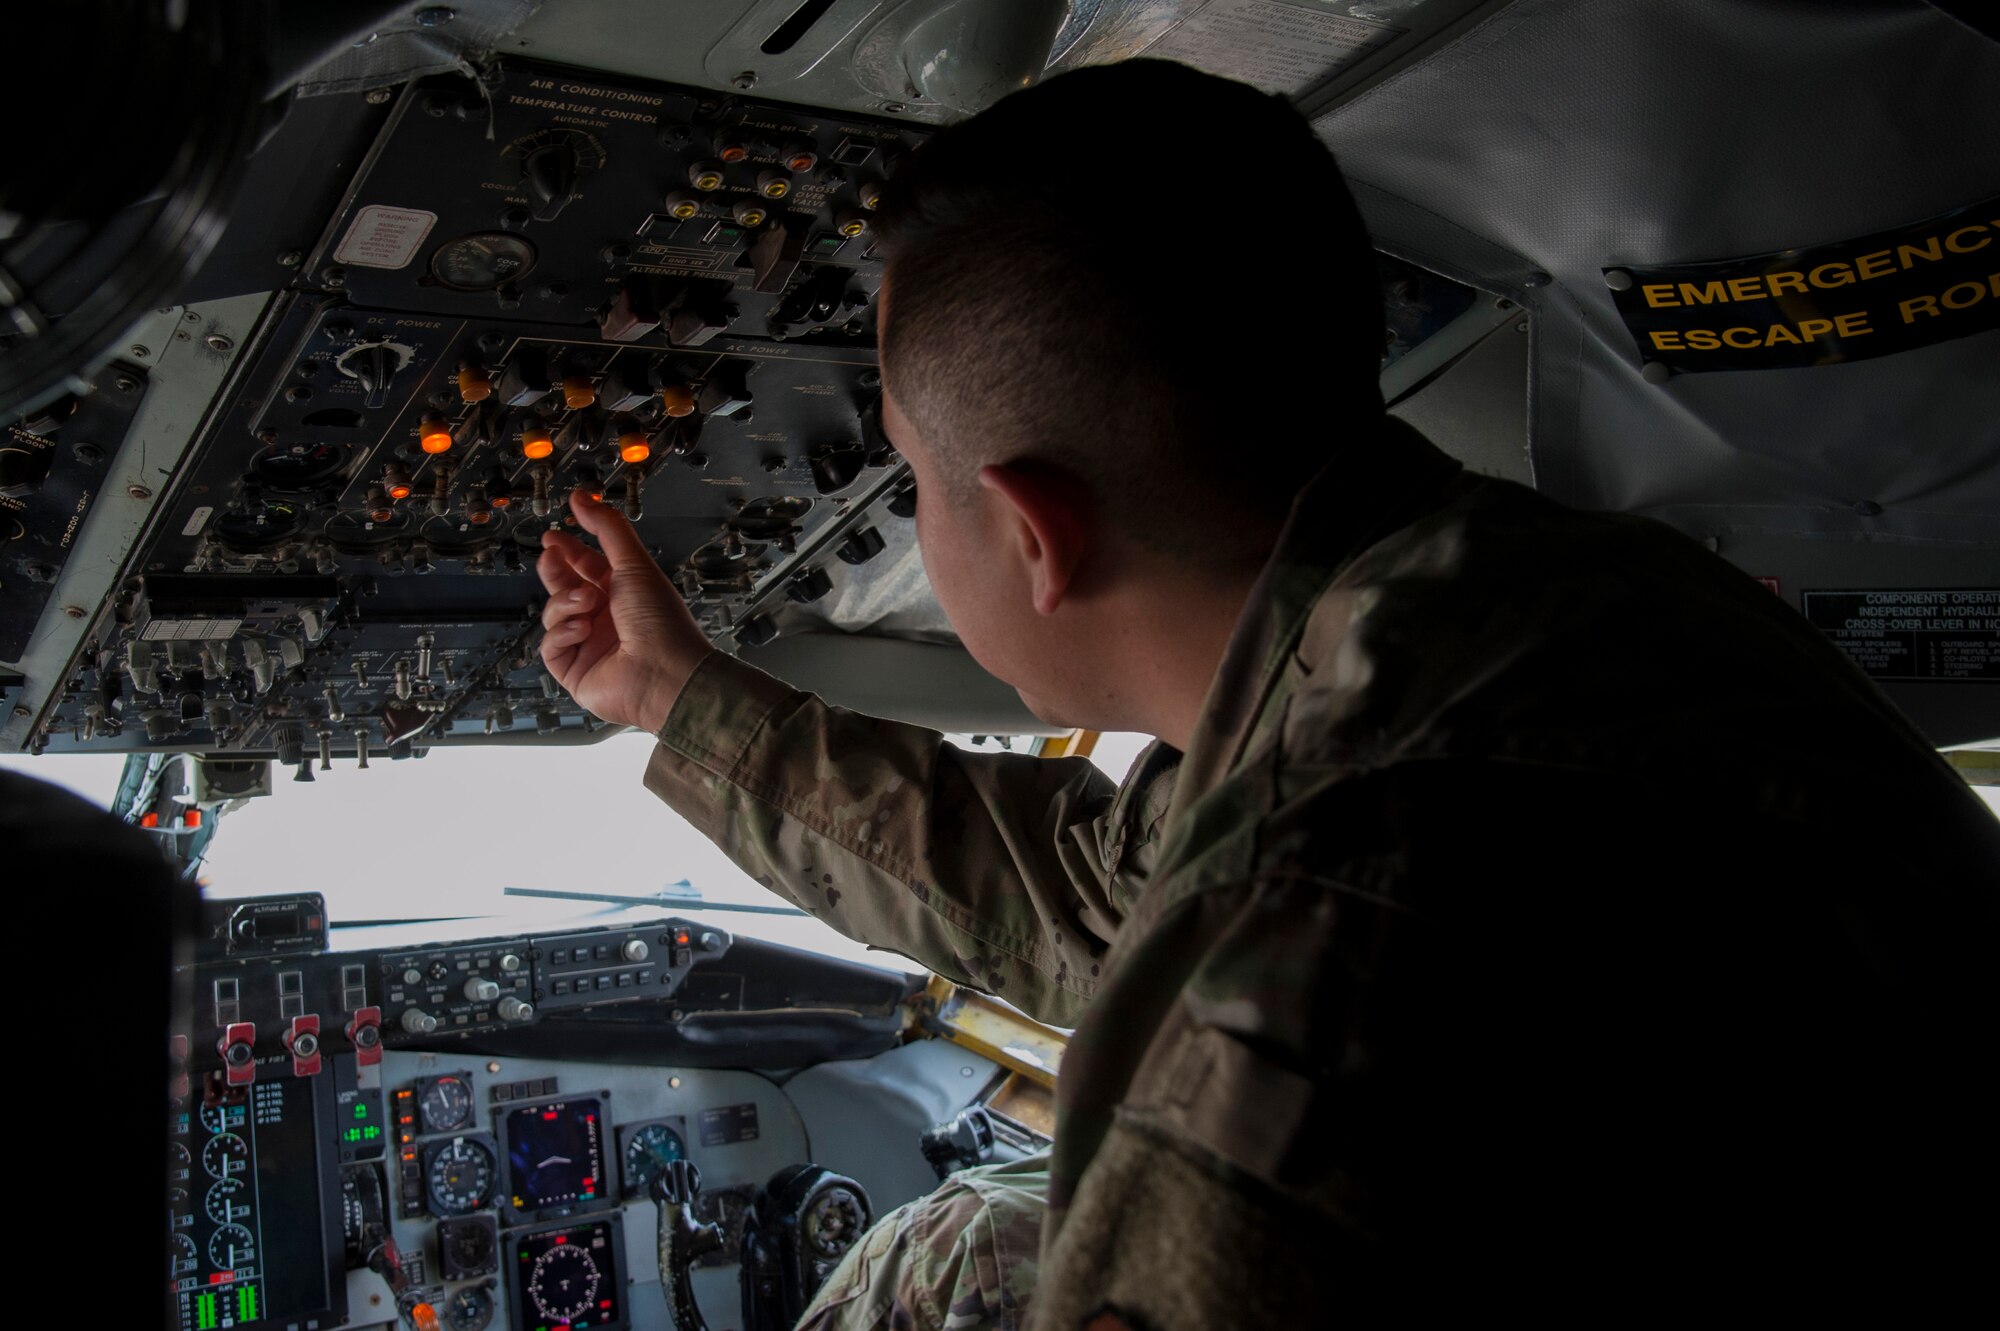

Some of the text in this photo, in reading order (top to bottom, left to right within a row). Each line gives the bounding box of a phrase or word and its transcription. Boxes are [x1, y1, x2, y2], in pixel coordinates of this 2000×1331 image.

[1280, 15, 1317, 29] PRESSURE
[1318, 24, 1369, 38] CONTROLLER
[1310, 15, 1368, 31] MALFUNCTION
[529, 79, 664, 106] AIR CONDITIONING
[510, 95, 659, 124] TEMPERATURE CONTROL
[552, 115, 610, 129] AUTOMATIC
[839, 126, 863, 137] PRESS
[879, 131, 900, 141] TEST
[752, 155, 777, 164] PRESS
[480, 182, 517, 192] COOLER
[801, 184, 838, 195] CROSS
[504, 196, 529, 204] MAN
[796, 191, 825, 200] OVER
[792, 197, 826, 208] VALVE
[377, 212, 420, 223] WARNING
[643, 246, 662, 254] APU
[1642, 219, 2000, 309] EMERGENC
[629, 266, 740, 282] ALTERNATE PRESSURE
[367, 317, 442, 329] DC POWER
[1648, 310, 1875, 351] ESCAPE
[726, 343, 790, 356] AC POWER
[8, 426, 56, 448] FORWARD
[13, 434, 46, 450] FLOOD
[60, 515, 80, 549] CONTROL
[1866, 593, 2000, 605] COMPONENTS OPERAT
[1858, 605, 1943, 617] INDEPENDENT
[1844, 618, 1923, 630] CROSS-OVER
[1926, 618, 1964, 630] LEVER
[1968, 618, 1981, 630] IN
[1851, 630, 1884, 638] SYSTEM
[1864, 640, 1903, 648] SPOILERS
[1941, 640, 1985, 648] OUTBOARD
[1852, 647, 1908, 655] REFUEL PUMPS
[1943, 655, 1986, 663] CO-PILOTS
[1866, 661, 1888, 669] GEAR
[1943, 662, 1984, 670] STEERING
[1943, 669, 1969, 677] FLAPS
[254, 903, 299, 914] ALTITUDE ALERT
